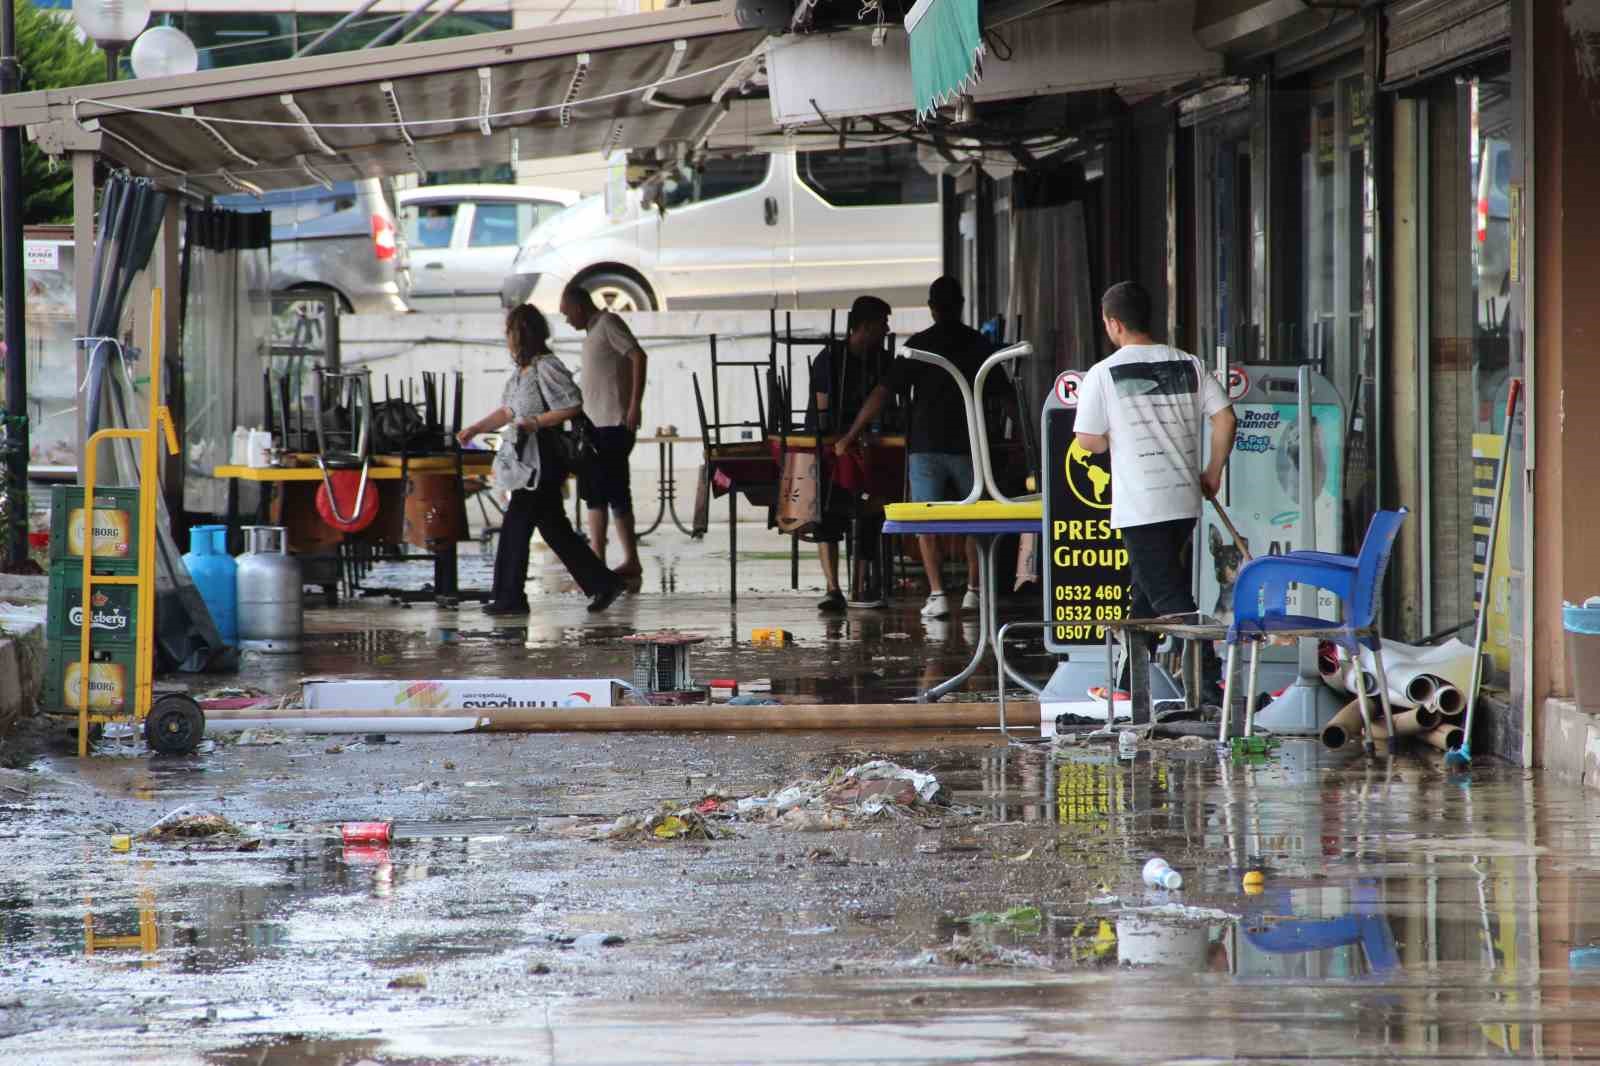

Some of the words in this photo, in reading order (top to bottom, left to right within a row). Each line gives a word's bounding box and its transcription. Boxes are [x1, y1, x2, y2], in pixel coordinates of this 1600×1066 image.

[1244, 410, 1280, 420] Road
[83, 527, 119, 537] BORG
[1053, 546, 1129, 571] Group
[1055, 585, 1092, 600] 0532
[1095, 585, 1122, 600] 460
[69, 606, 127, 629] Calsberg
[1056, 605, 1092, 621] 0532
[1095, 605, 1122, 621] 059
[1056, 624, 1093, 640] 0507
